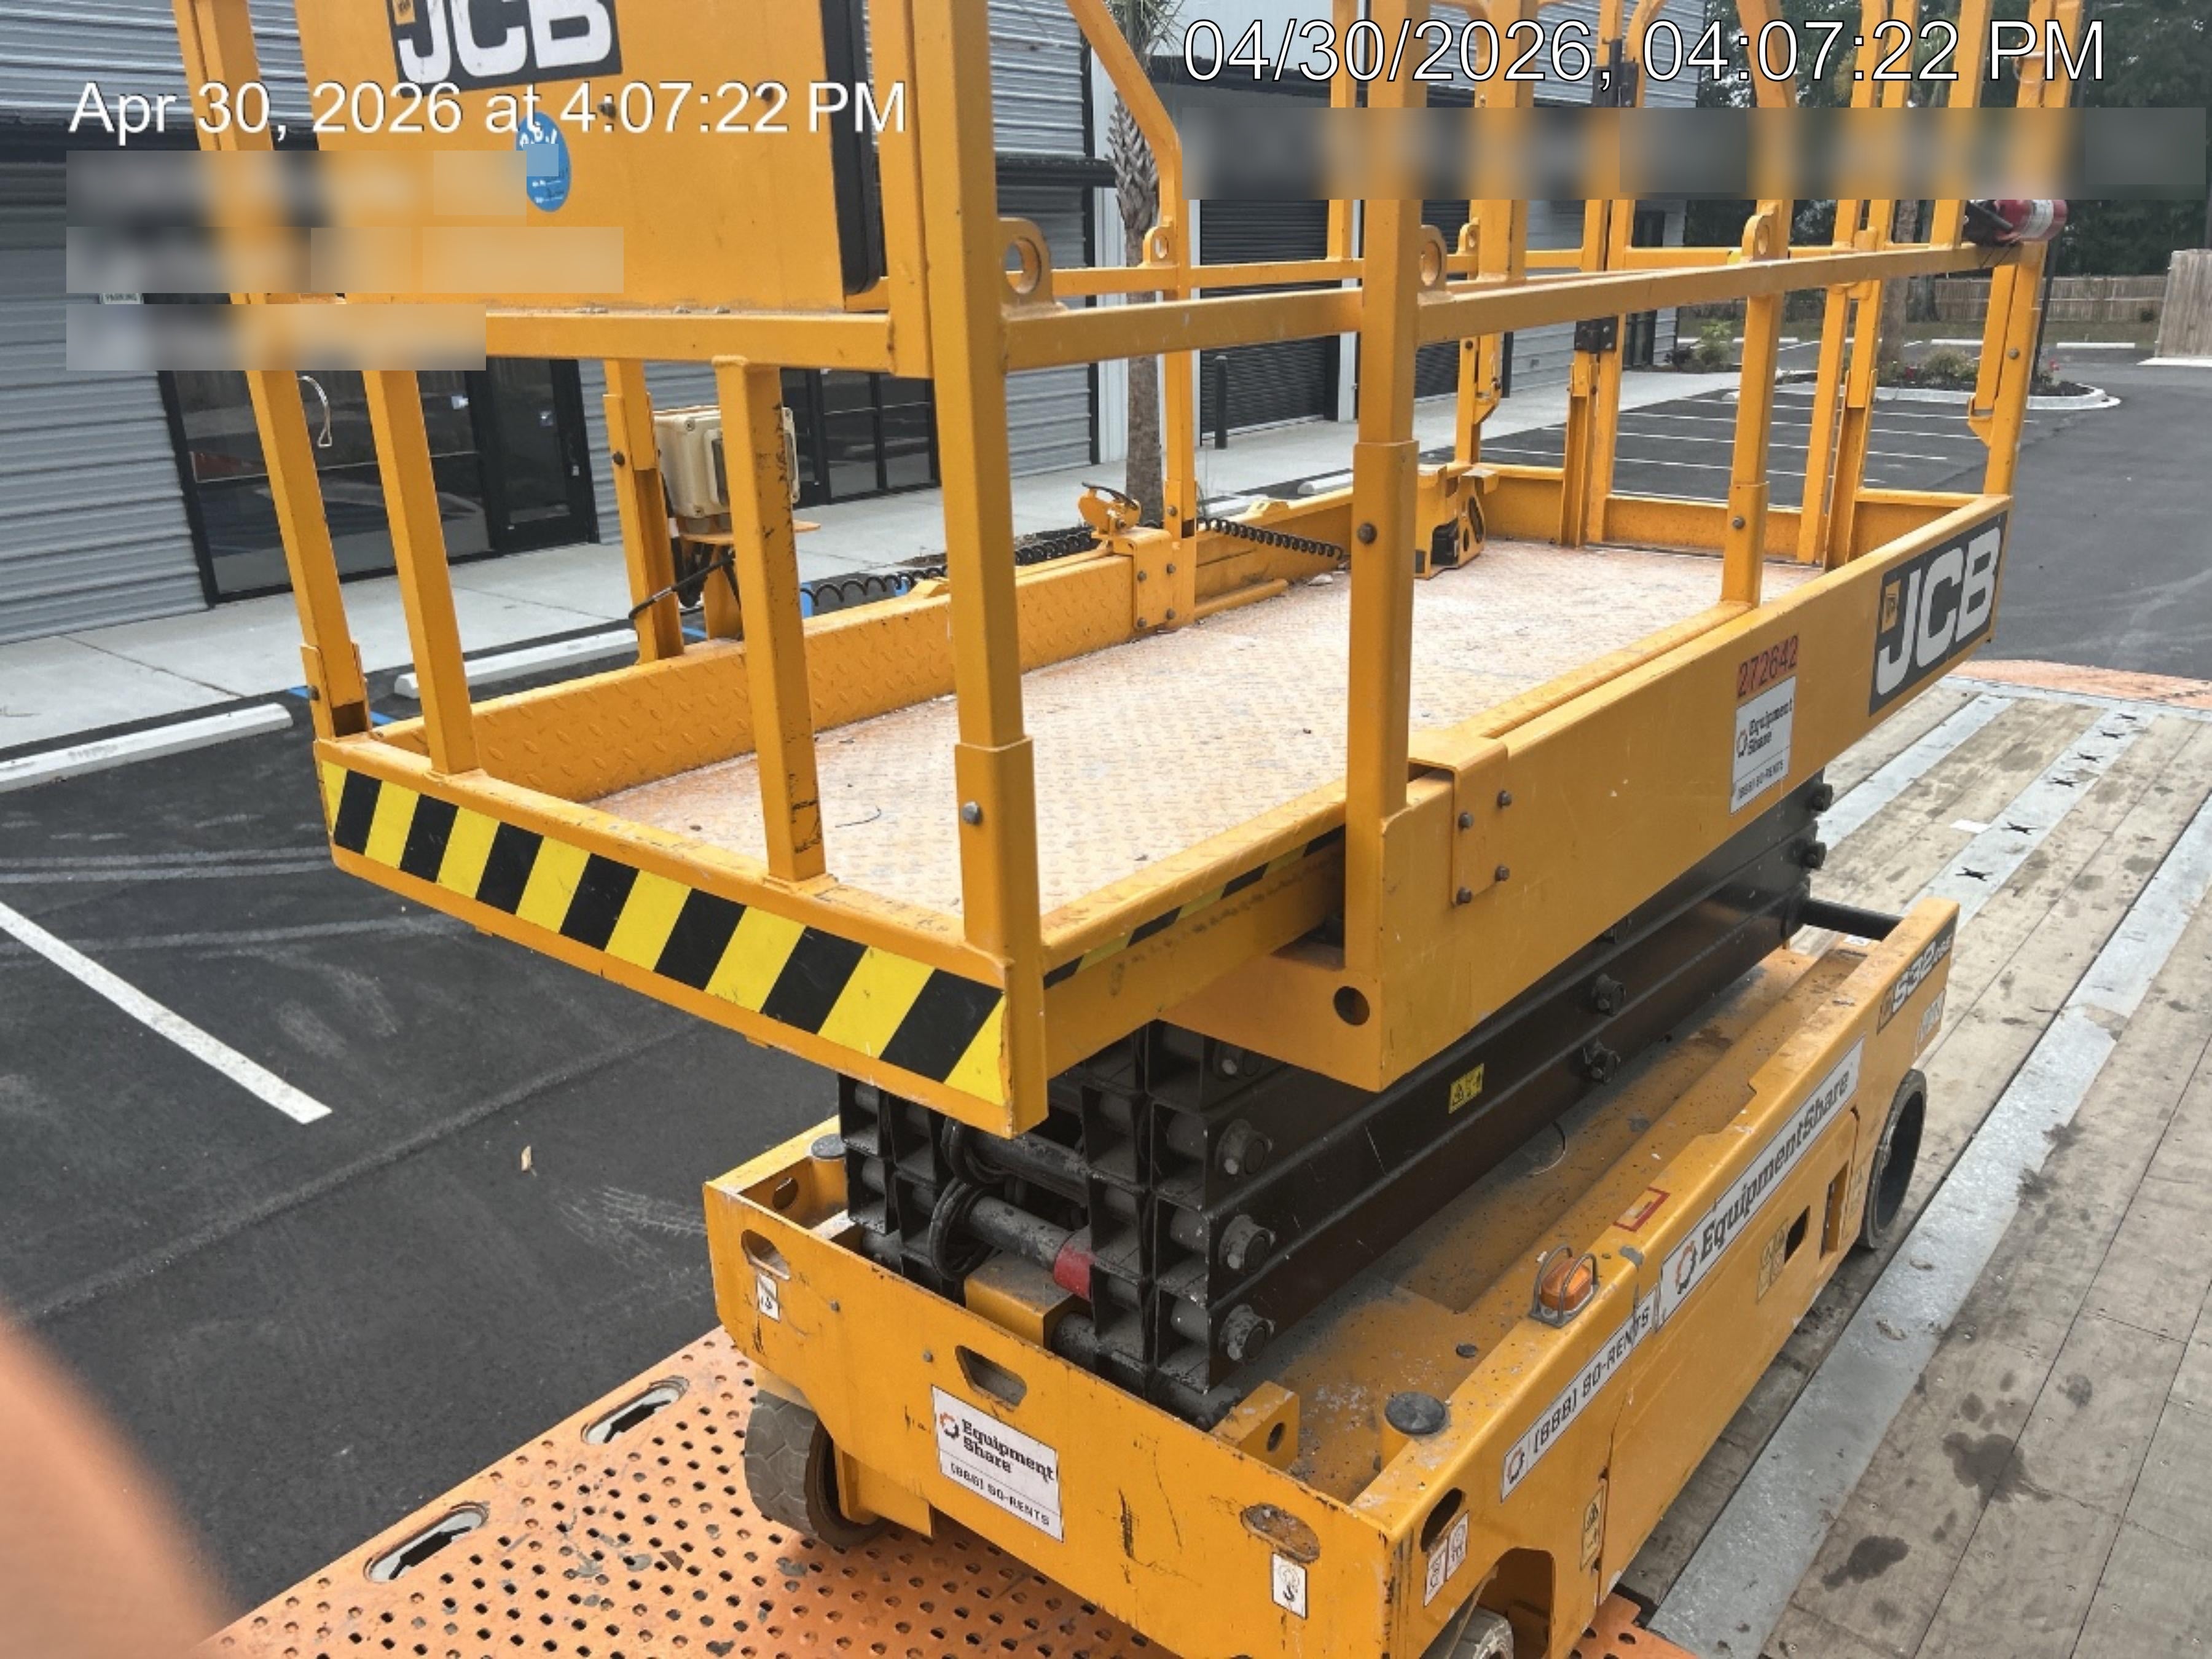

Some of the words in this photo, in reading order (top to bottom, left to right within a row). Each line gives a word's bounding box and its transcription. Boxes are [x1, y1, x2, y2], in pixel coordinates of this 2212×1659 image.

[398, 0, 612, 84] JCB
[1876, 527, 2001, 696] JCB
[1738, 635, 1798, 697] 272642
[1700, 1070, 1849, 1263] EquipmentShare
[1533, 1387, 1577, 1453] (888)
[1582, 1306, 1650, 1398] 80-RENTS
[962, 1418, 1054, 1481] Equipment
[963, 1436, 1013, 1473] Share
